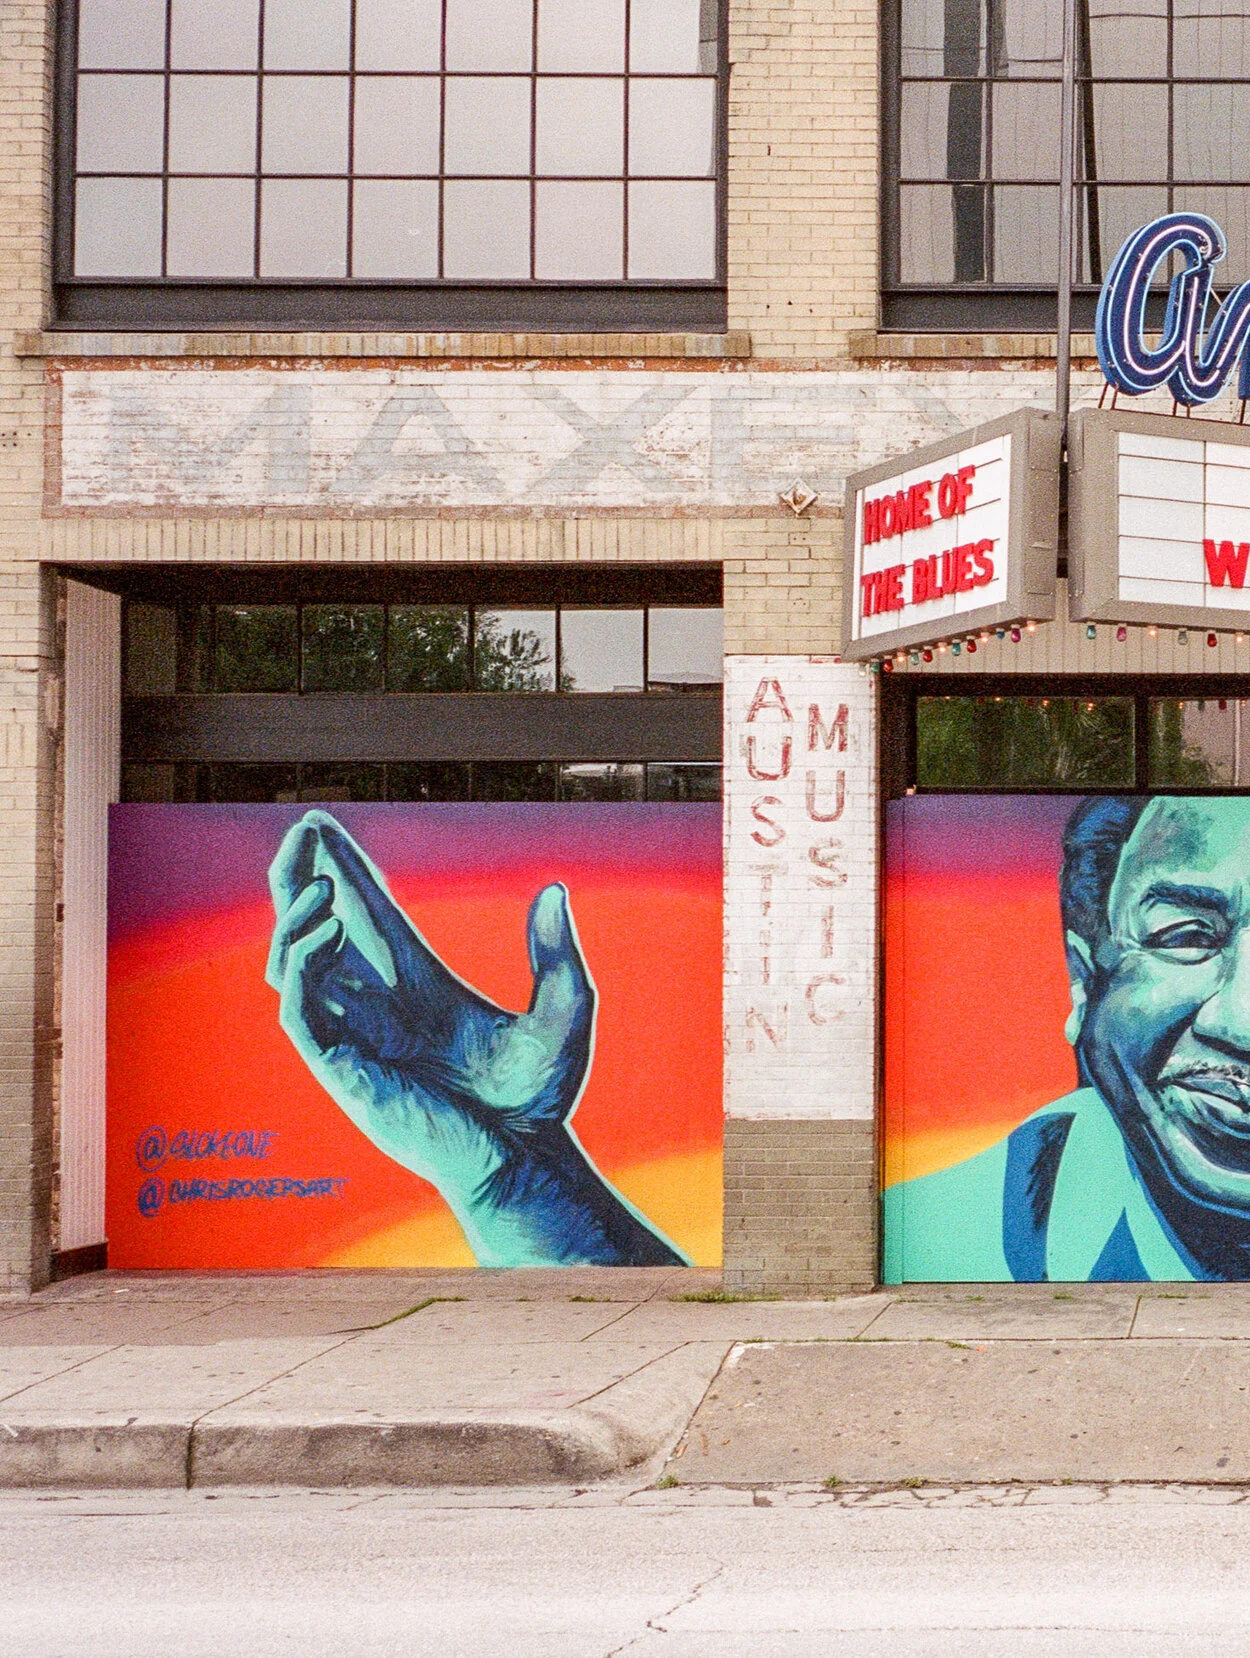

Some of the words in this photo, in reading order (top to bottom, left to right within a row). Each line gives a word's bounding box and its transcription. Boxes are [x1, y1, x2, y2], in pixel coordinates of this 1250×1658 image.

[860, 564, 905, 617] THE
[912, 539, 994, 604] BLUES
[864, 480, 932, 545] HOME
[938, 465, 975, 519] OF
[746, 676, 794, 1052] AUSTIN
[805, 703, 849, 1026] MUSIC
